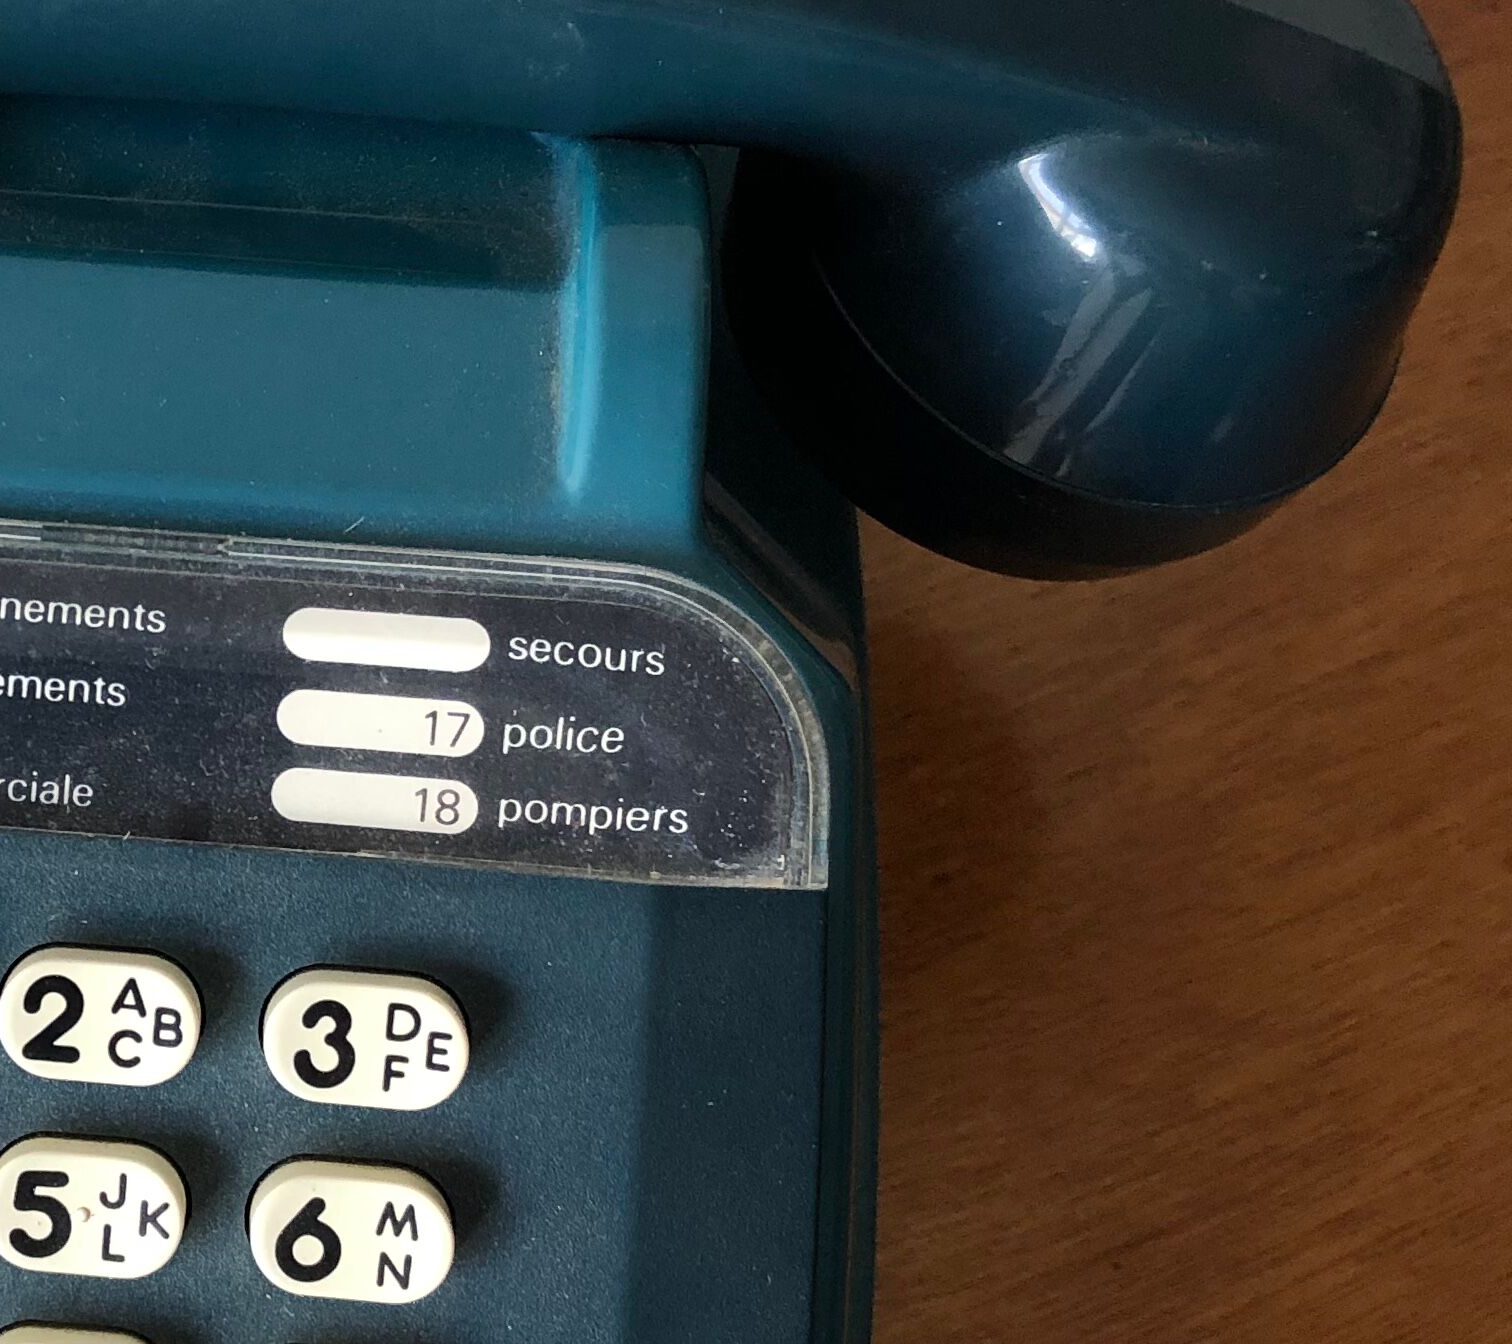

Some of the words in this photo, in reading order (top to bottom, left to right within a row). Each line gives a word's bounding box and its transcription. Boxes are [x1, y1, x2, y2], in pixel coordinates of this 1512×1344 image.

[508, 635, 665, 675] secours
[424, 710, 470, 748] 17
[502, 716, 624, 755] police
[415, 787, 460, 825] 18
[498, 797, 689, 835] pompiers
[22, 975, 84, 1063] 2
[294, 1000, 355, 1088] 3
[9, 1171, 71, 1258] 5
[275, 1197, 341, 1282] 6
